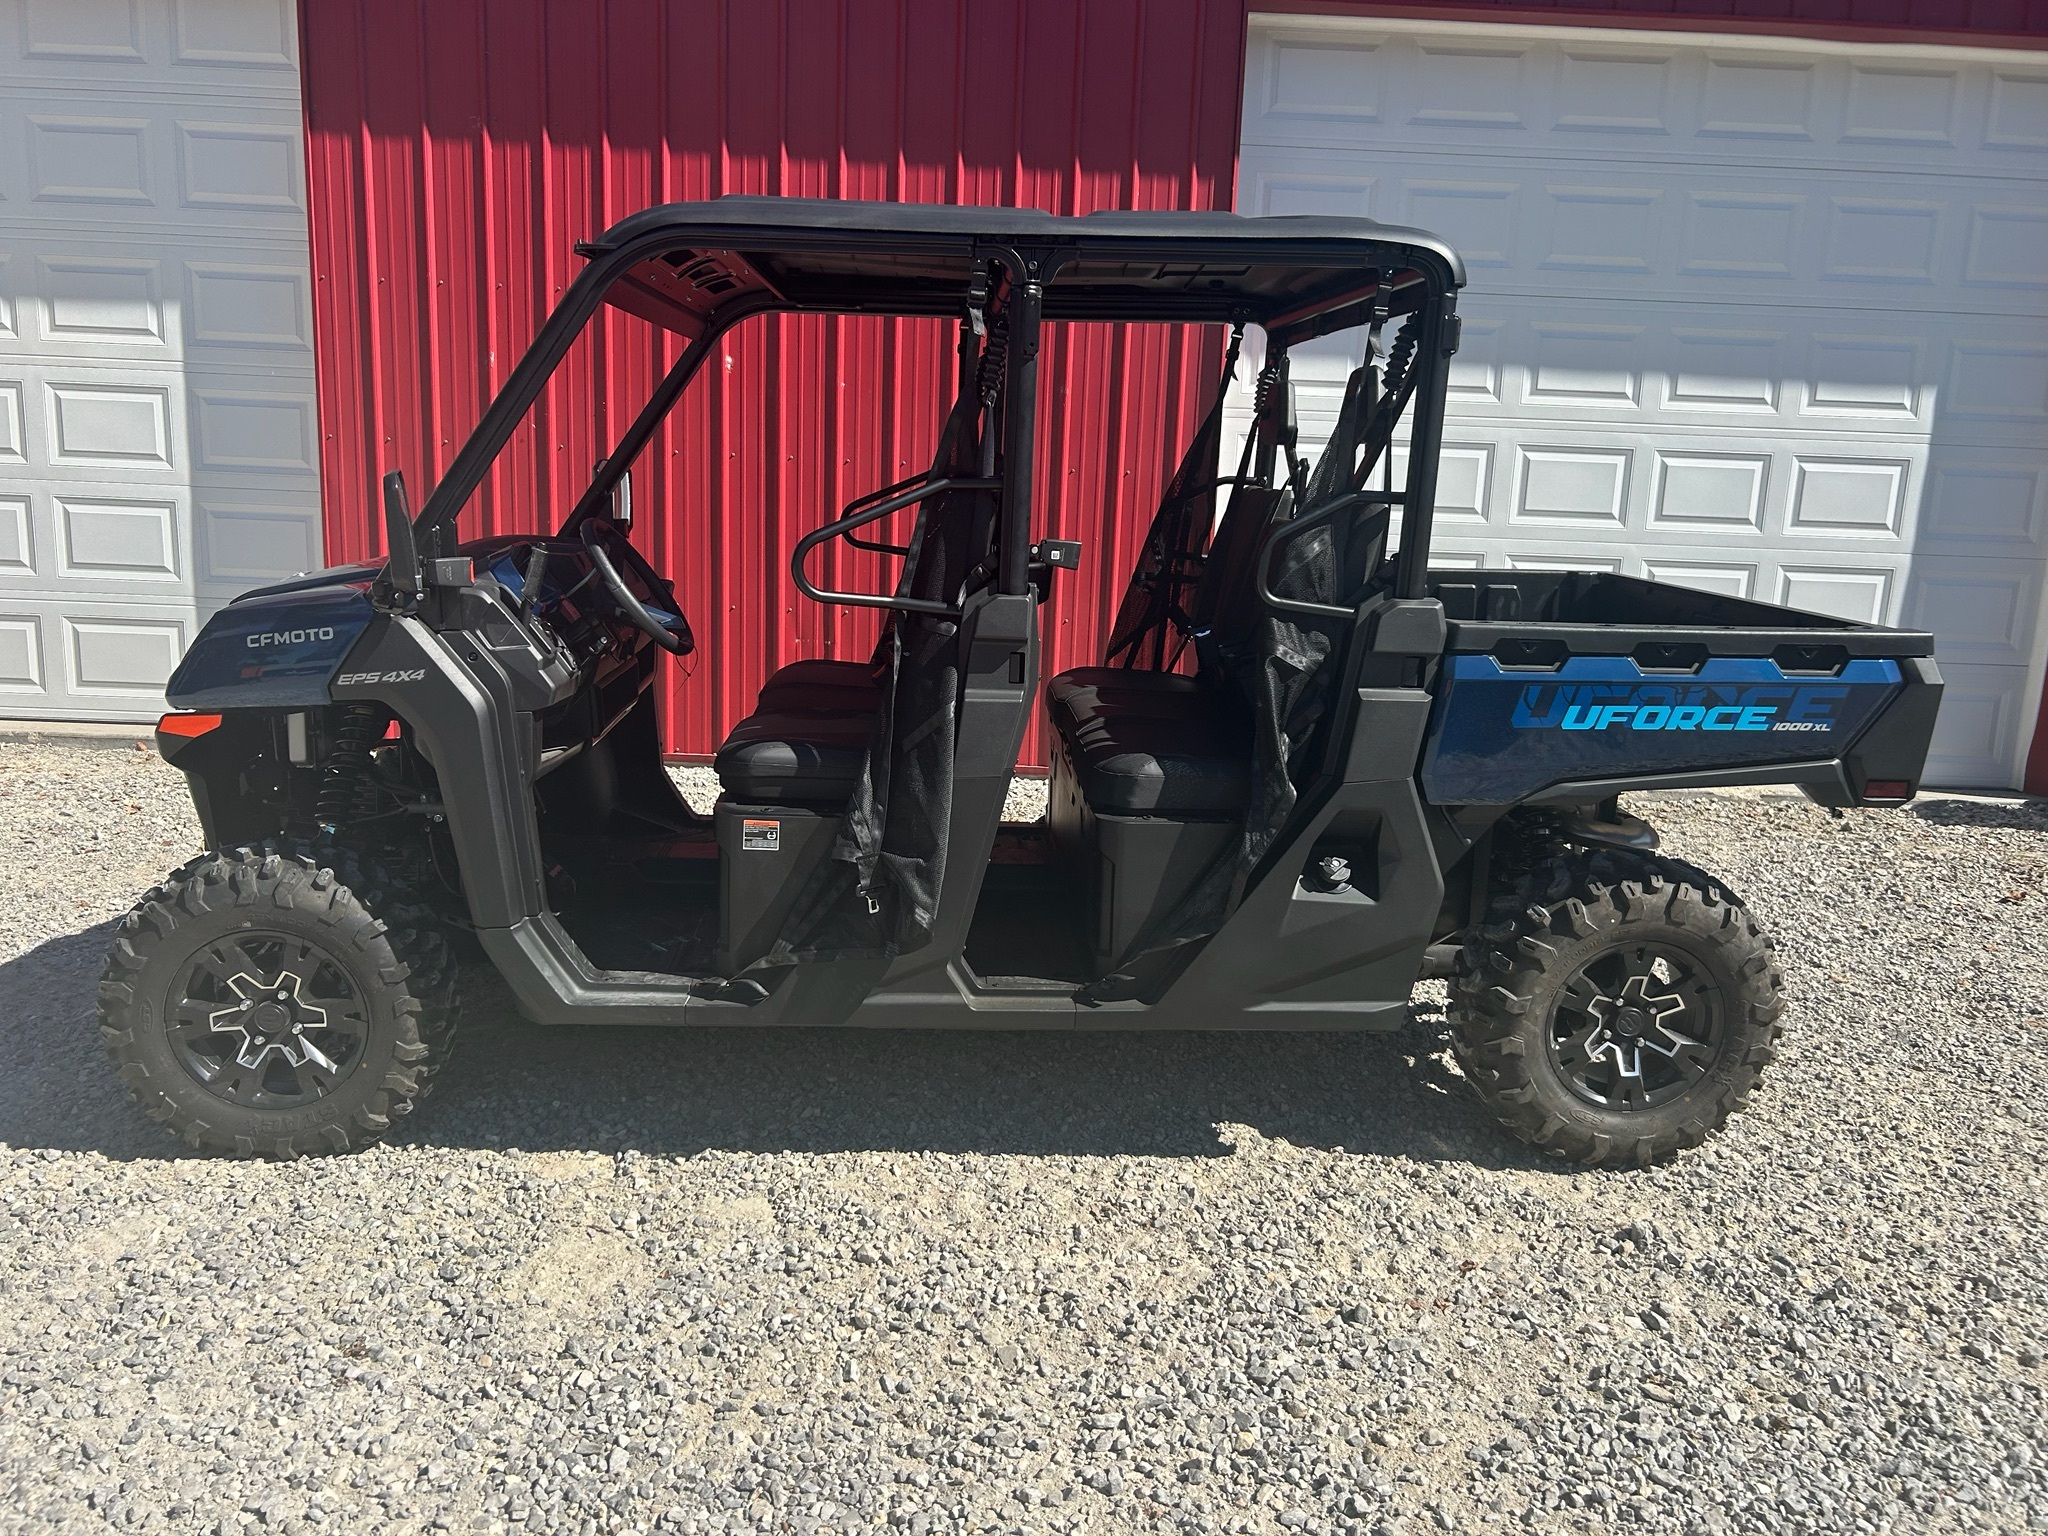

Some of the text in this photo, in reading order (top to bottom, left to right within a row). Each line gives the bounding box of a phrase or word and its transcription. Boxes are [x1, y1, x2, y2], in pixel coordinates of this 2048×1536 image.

[246, 626, 334, 648] CFMOTO
[337, 669, 426, 685] EPS 4X4
[1560, 705, 1831, 732] UFORCE 1000 XL
